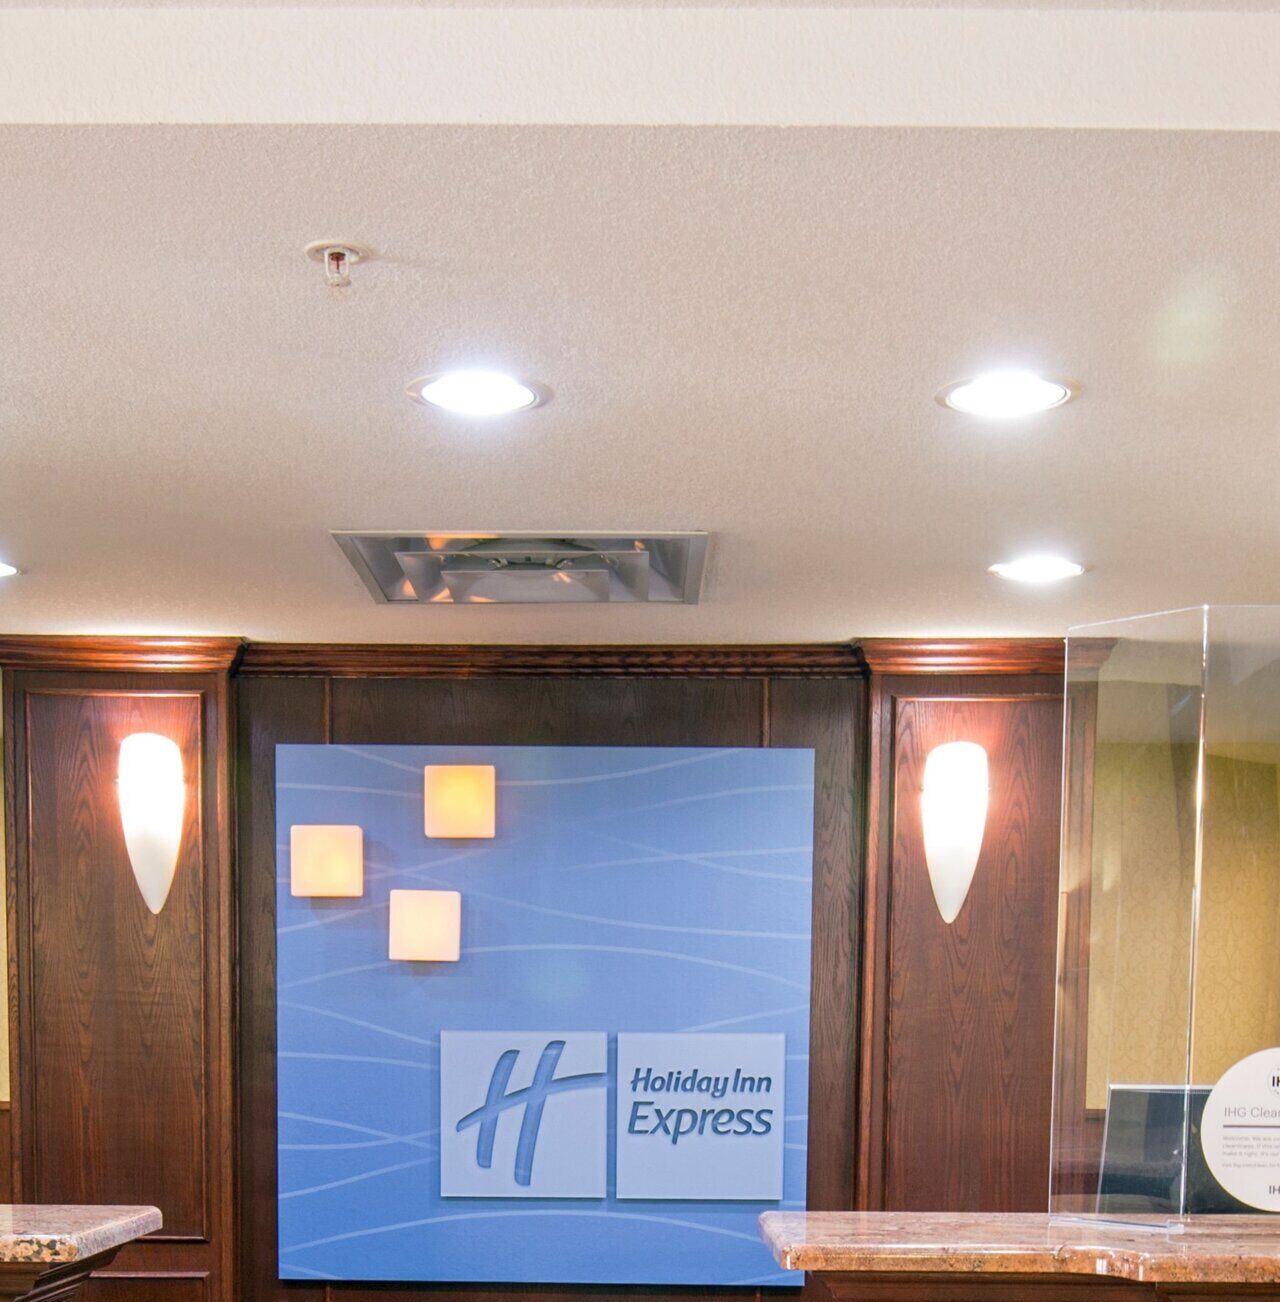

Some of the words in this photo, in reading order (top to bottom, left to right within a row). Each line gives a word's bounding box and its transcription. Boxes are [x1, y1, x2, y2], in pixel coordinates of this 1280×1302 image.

[630, 1067, 729, 1099] Holiday
[732, 1068, 772, 1093] Inn
[627, 1101, 774, 1145] Express
[1224, 1107, 1246, 1118] IHG
